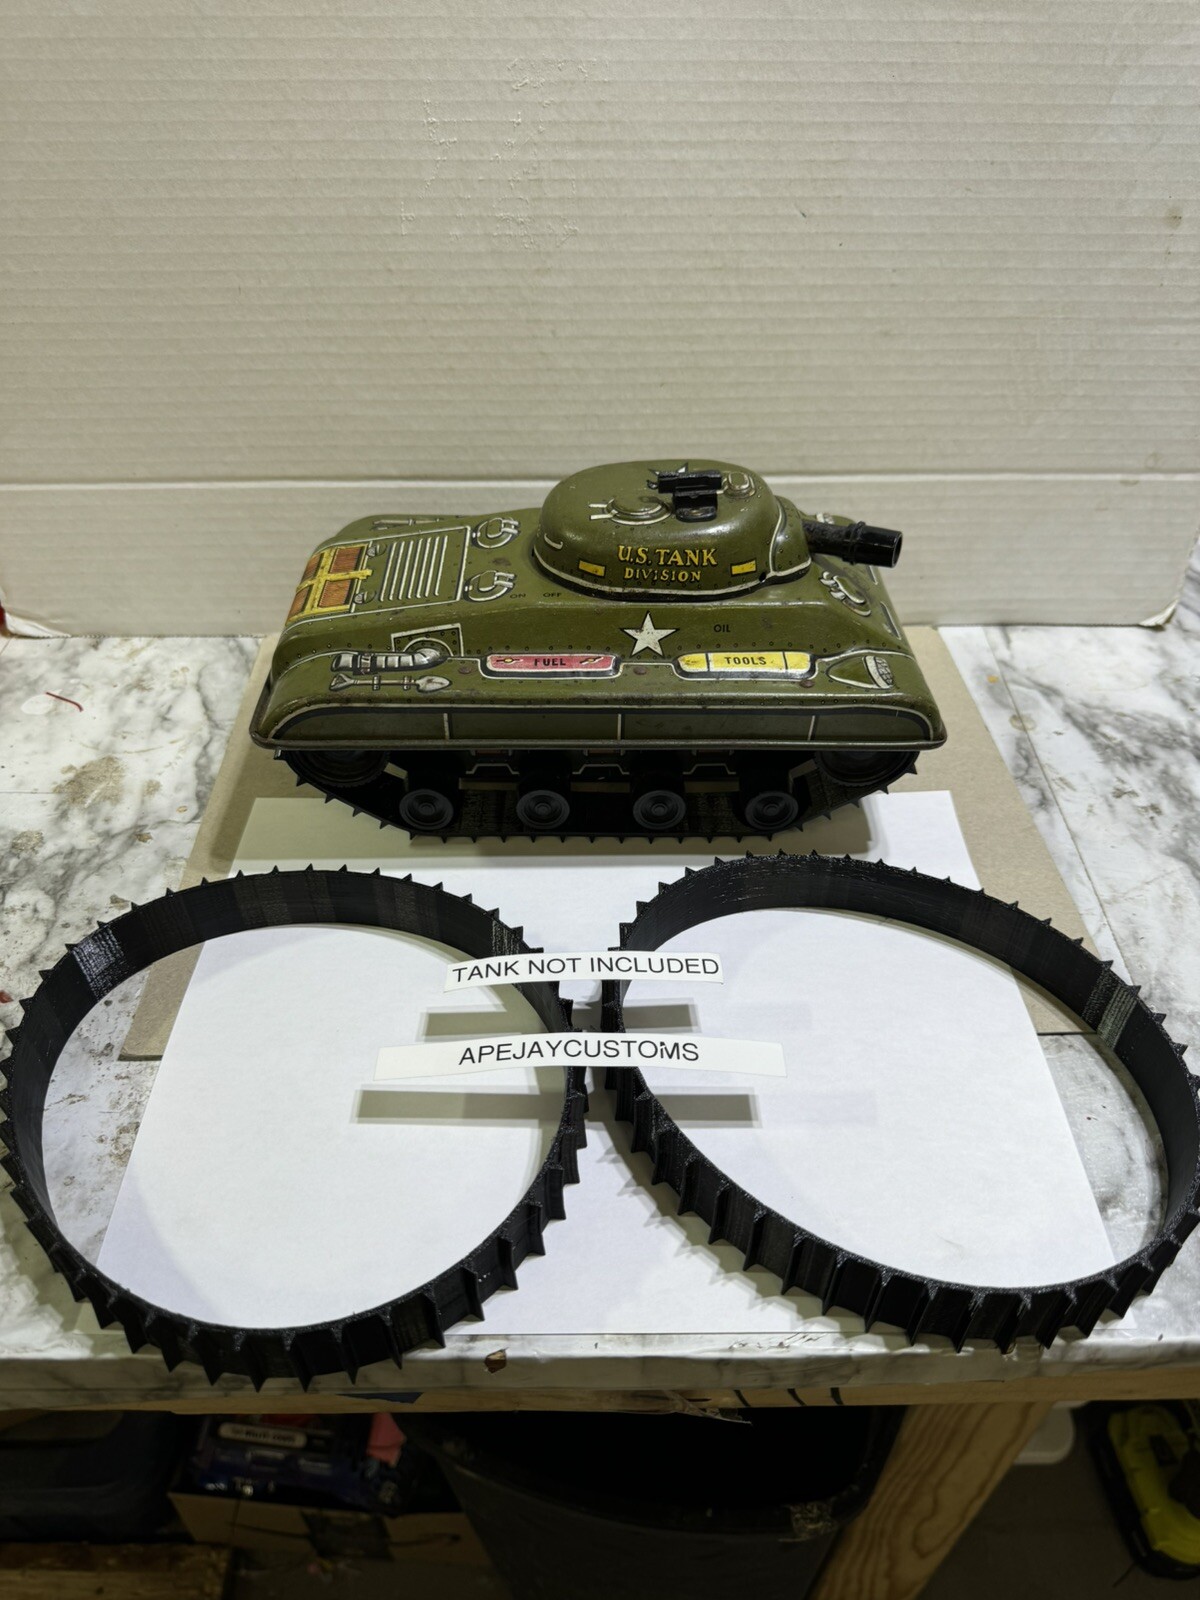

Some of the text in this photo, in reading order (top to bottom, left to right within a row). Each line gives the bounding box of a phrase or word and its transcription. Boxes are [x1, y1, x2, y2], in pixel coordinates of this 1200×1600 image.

[618, 545, 718, 566] U.S. TANK
[624, 567, 702, 582] DIVISION
[713, 624, 731, 633] OIL
[534, 658, 566, 666] FUEL
[724, 656, 767, 665] TOOLS
[452, 956, 719, 983] TANK NOT INCLUDED
[458, 1039, 700, 1066] APEJAYCUSTOMS
